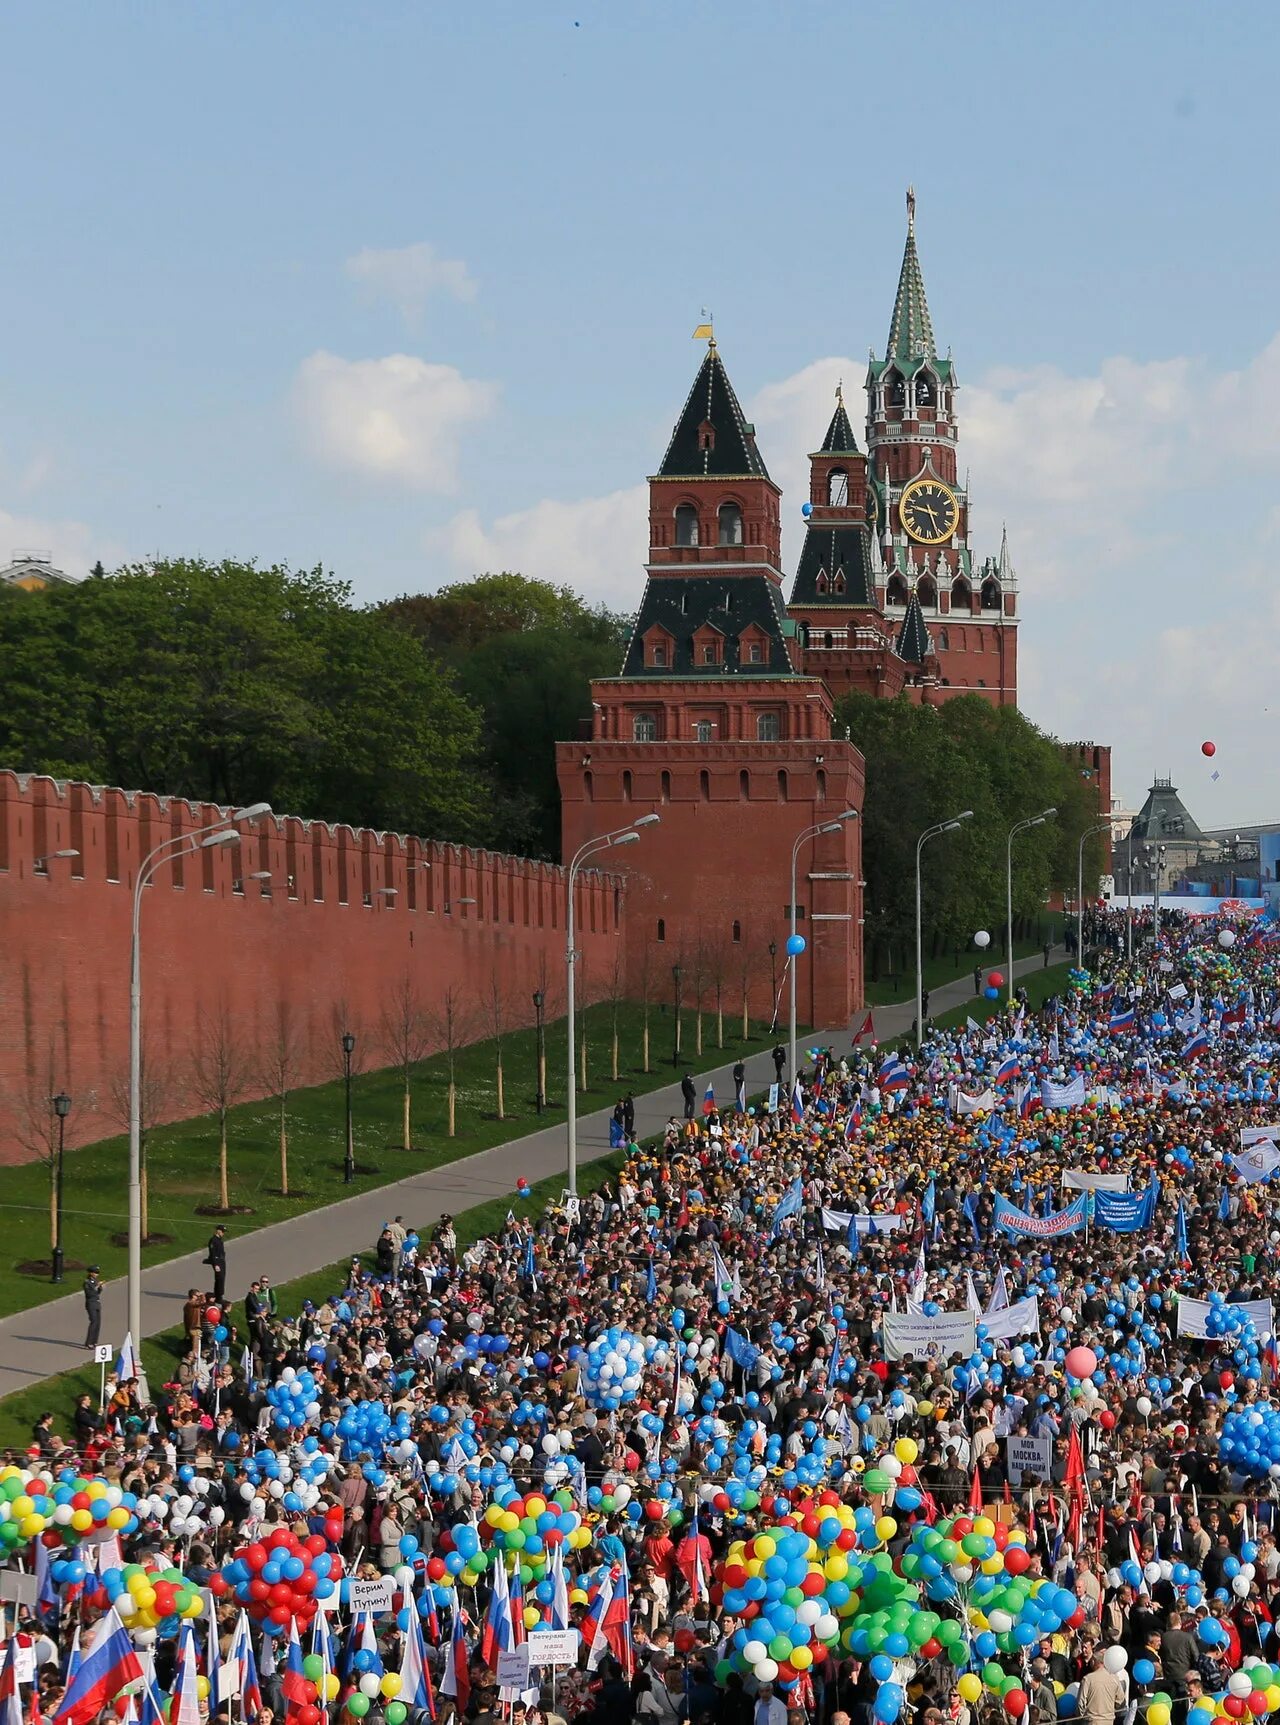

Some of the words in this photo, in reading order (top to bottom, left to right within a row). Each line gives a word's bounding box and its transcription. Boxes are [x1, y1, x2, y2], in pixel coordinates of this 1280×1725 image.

[570, 1200, 577, 1210] 8
[100, 1346, 107, 1360] 9
[1020, 1440, 1034, 1449] МОЯ
[354, 1584, 384, 1595] Верим
[353, 1594, 390, 1610] Путину!
